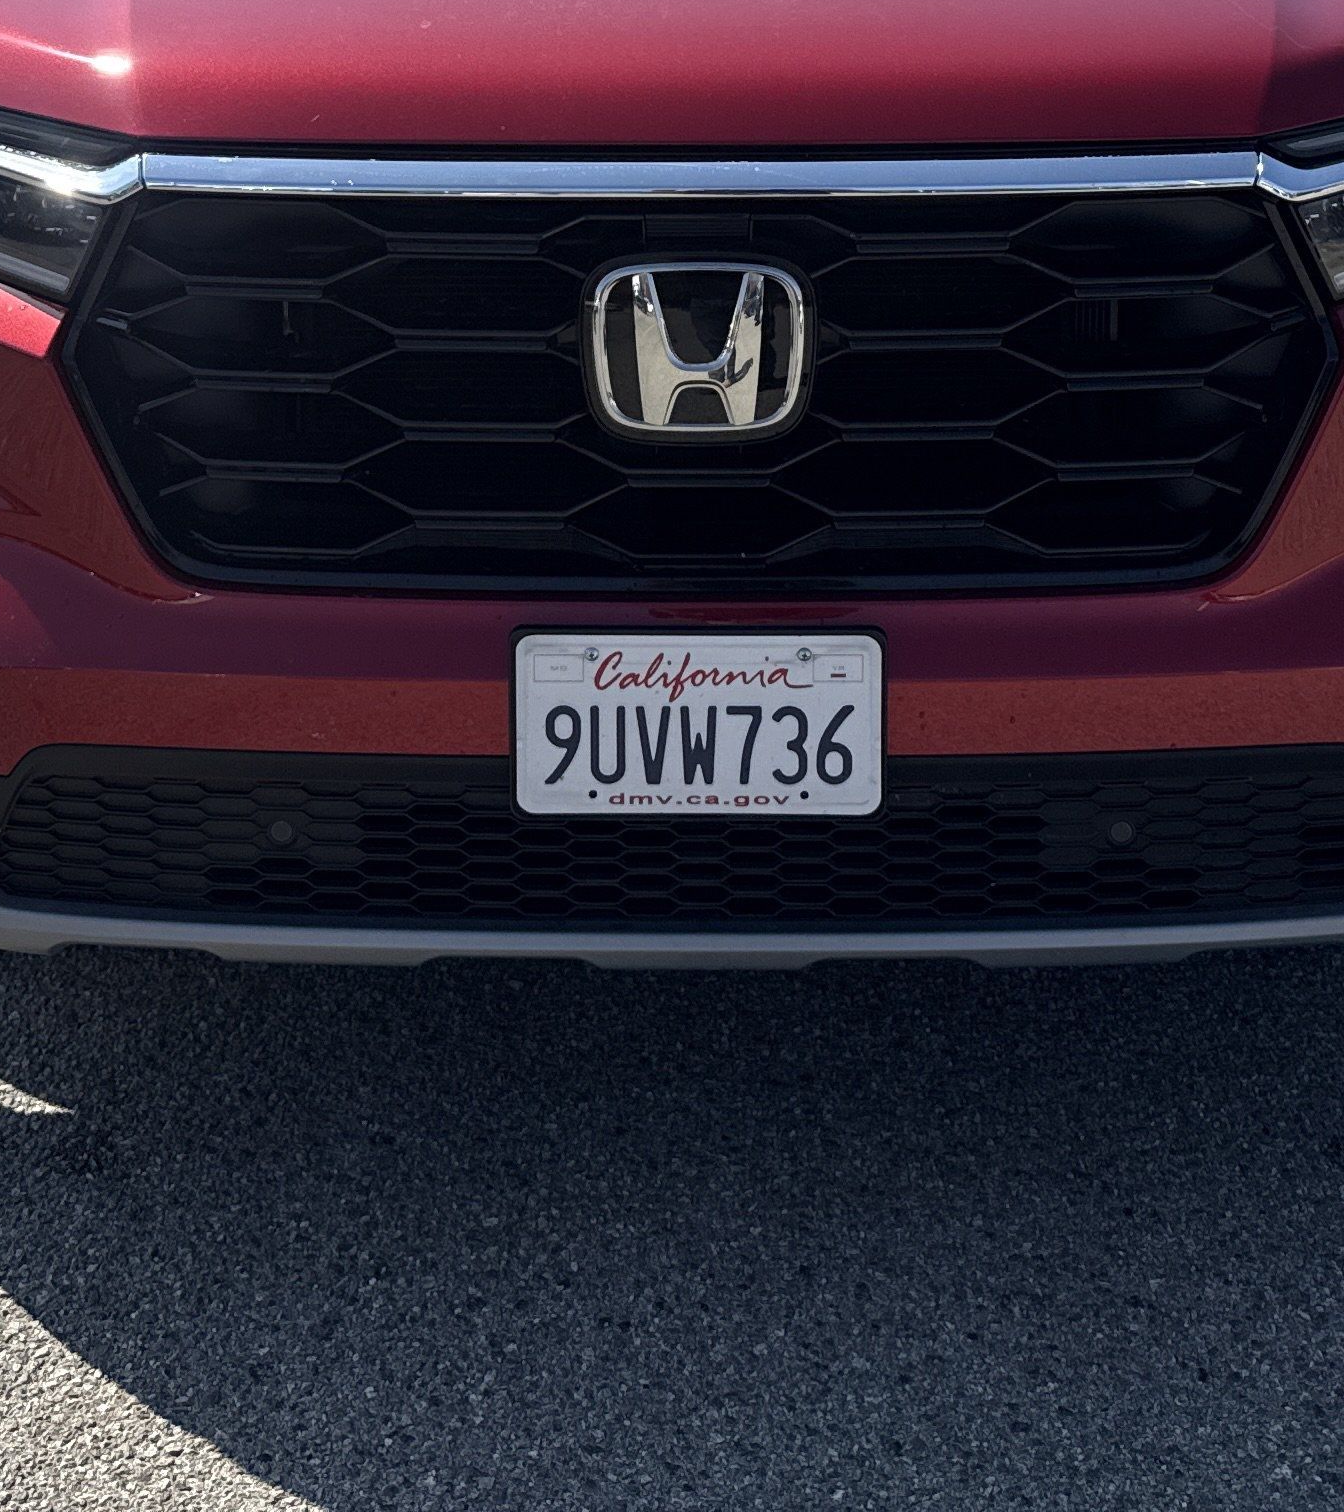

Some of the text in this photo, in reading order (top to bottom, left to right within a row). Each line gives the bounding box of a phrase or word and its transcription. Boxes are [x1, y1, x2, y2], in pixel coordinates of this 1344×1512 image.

[594, 651, 814, 702] California
[544, 705, 855, 785] 9UVW736
[609, 792, 790, 806] dmv.ca.gov
